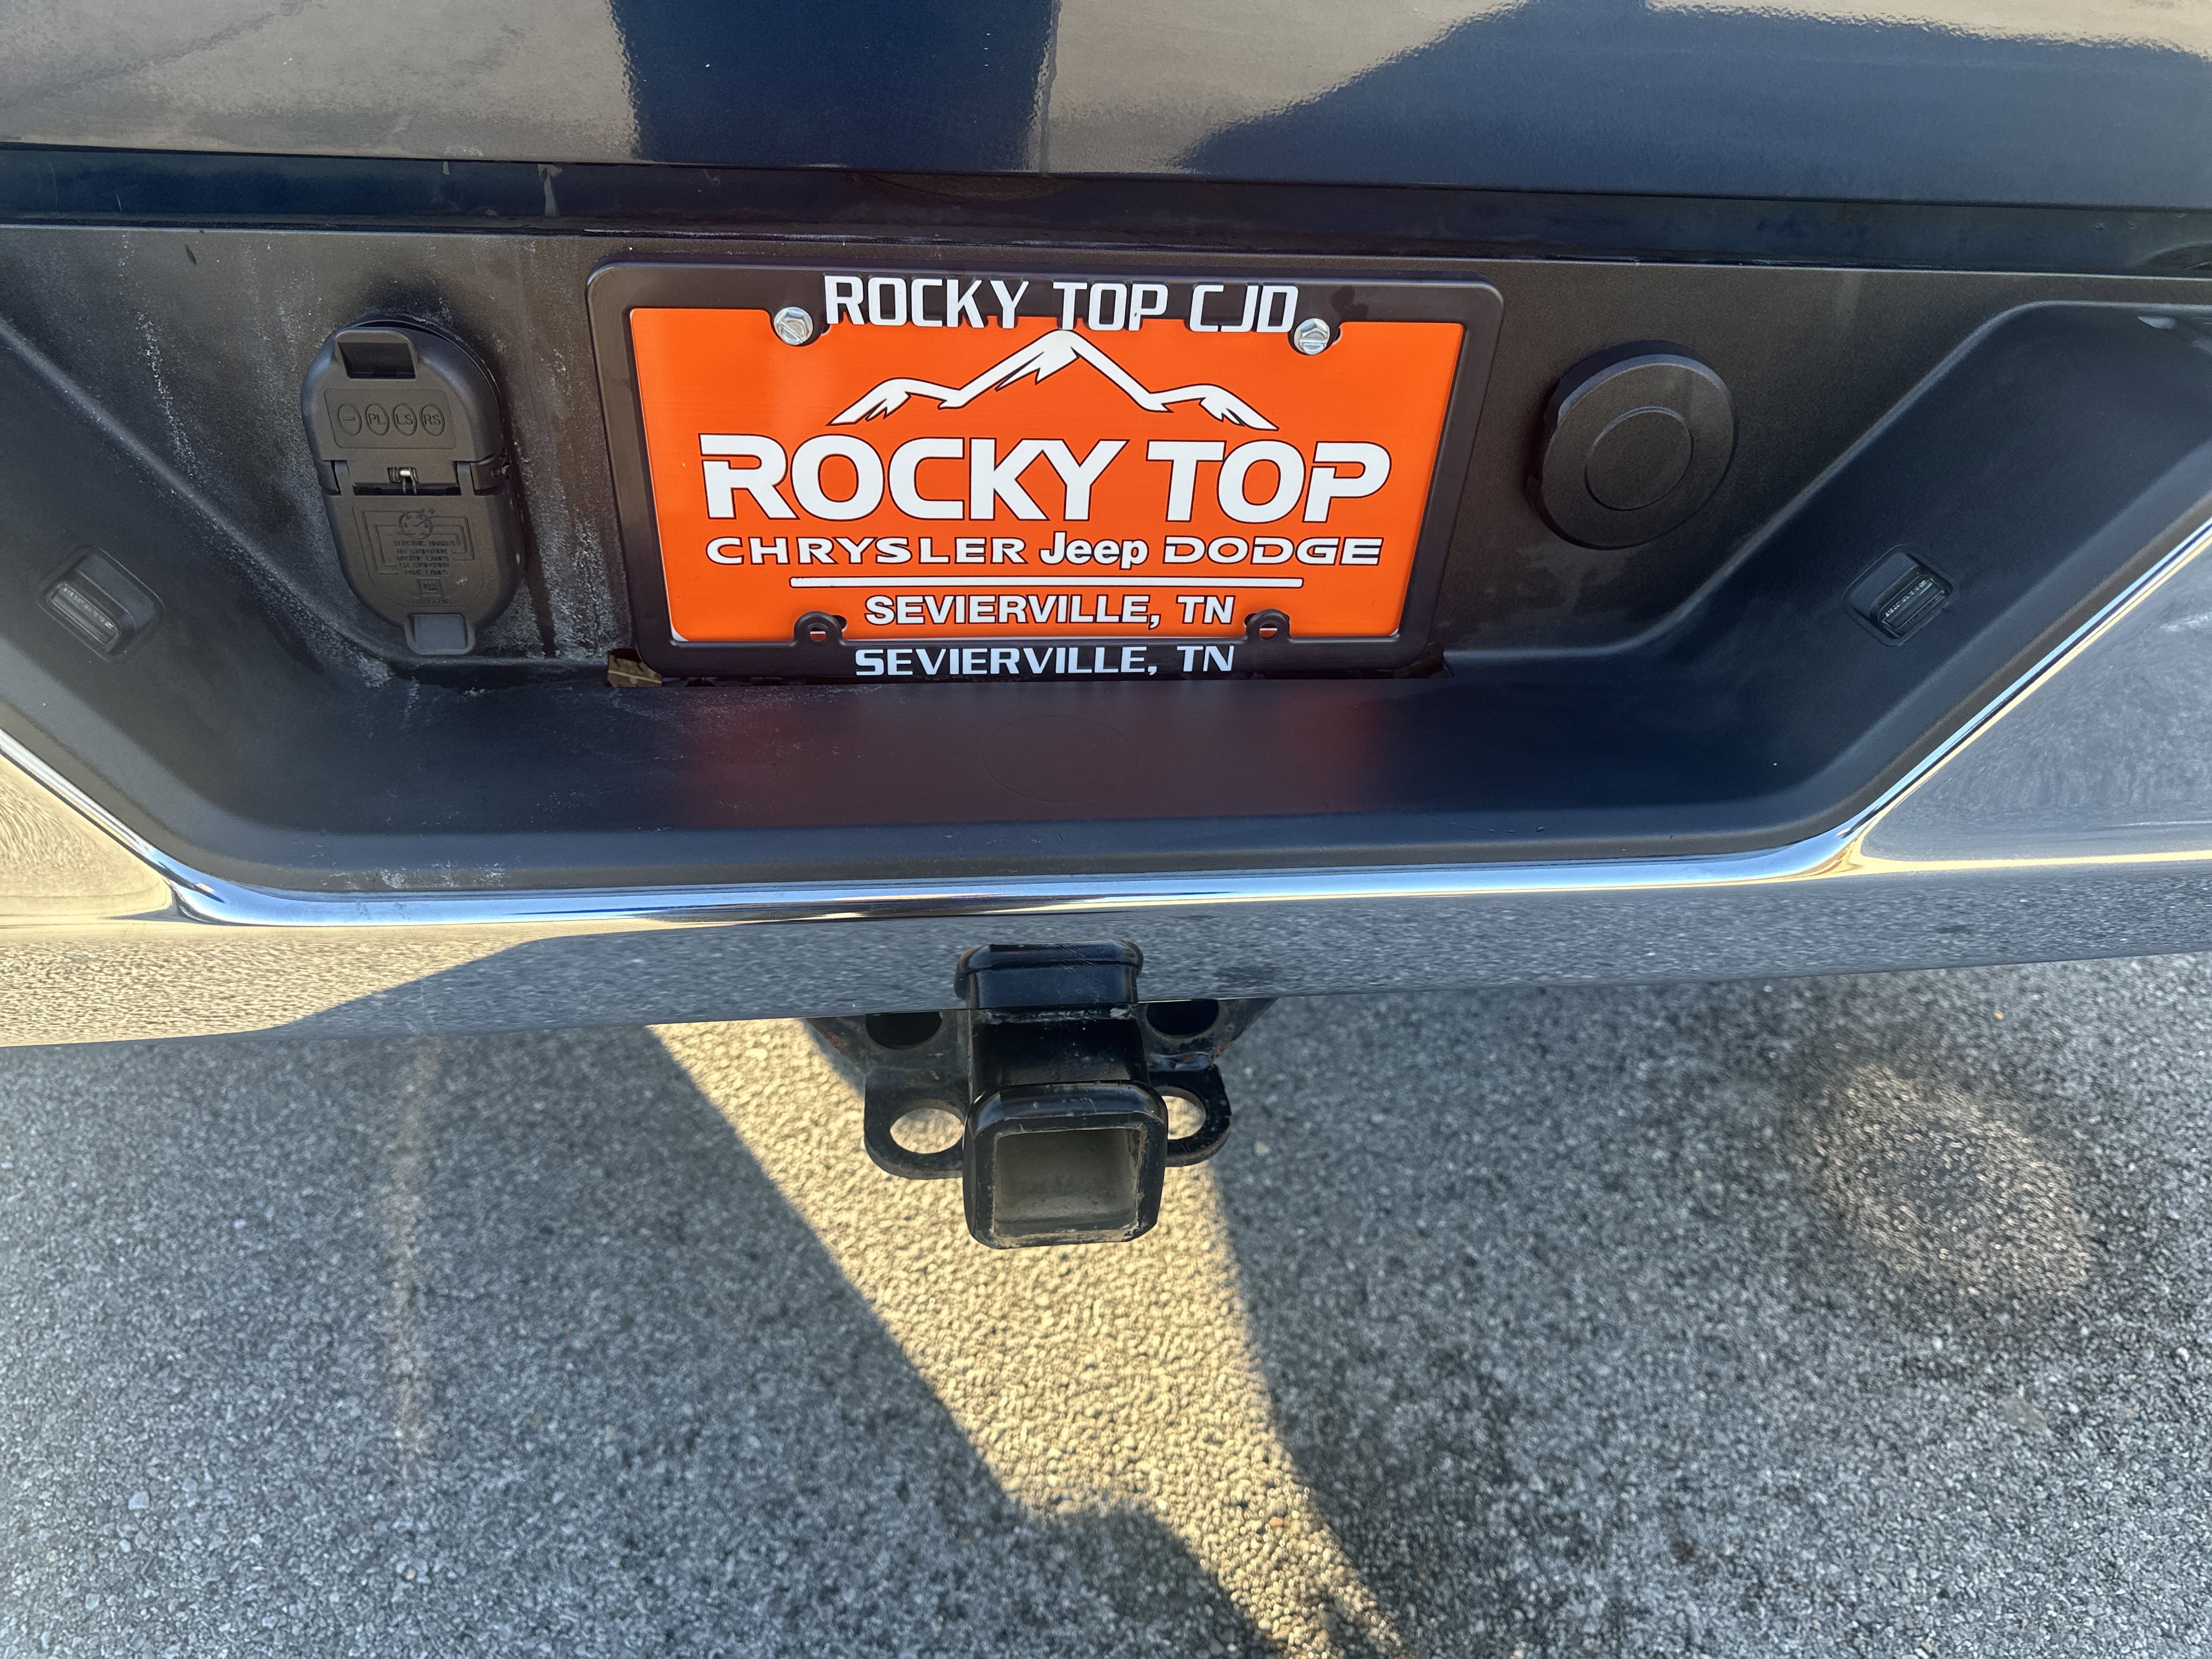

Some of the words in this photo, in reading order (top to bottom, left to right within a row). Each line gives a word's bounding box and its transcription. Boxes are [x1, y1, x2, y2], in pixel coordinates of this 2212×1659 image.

[824, 275, 1029, 329] ROCKY
[1053, 281, 1168, 331] TOP
[1189, 284, 1299, 333] CJD
[368, 413, 386, 425] PL
[395, 414, 413, 425] LS
[423, 414, 441, 425] RS
[699, 433, 1130, 521] ROCKY
[1146, 439, 1392, 524] TOP
[706, 536, 1029, 566] CHRYSLER
[1039, 531, 1148, 570] Jeep
[1162, 535, 1384, 566] DODGE
[865, 594, 1161, 630] SEVIERVILLE,
[1177, 594, 1235, 624] TN
[855, 646, 1158, 676] SEVIERVILLE,
[1176, 645, 1235, 673] TN
